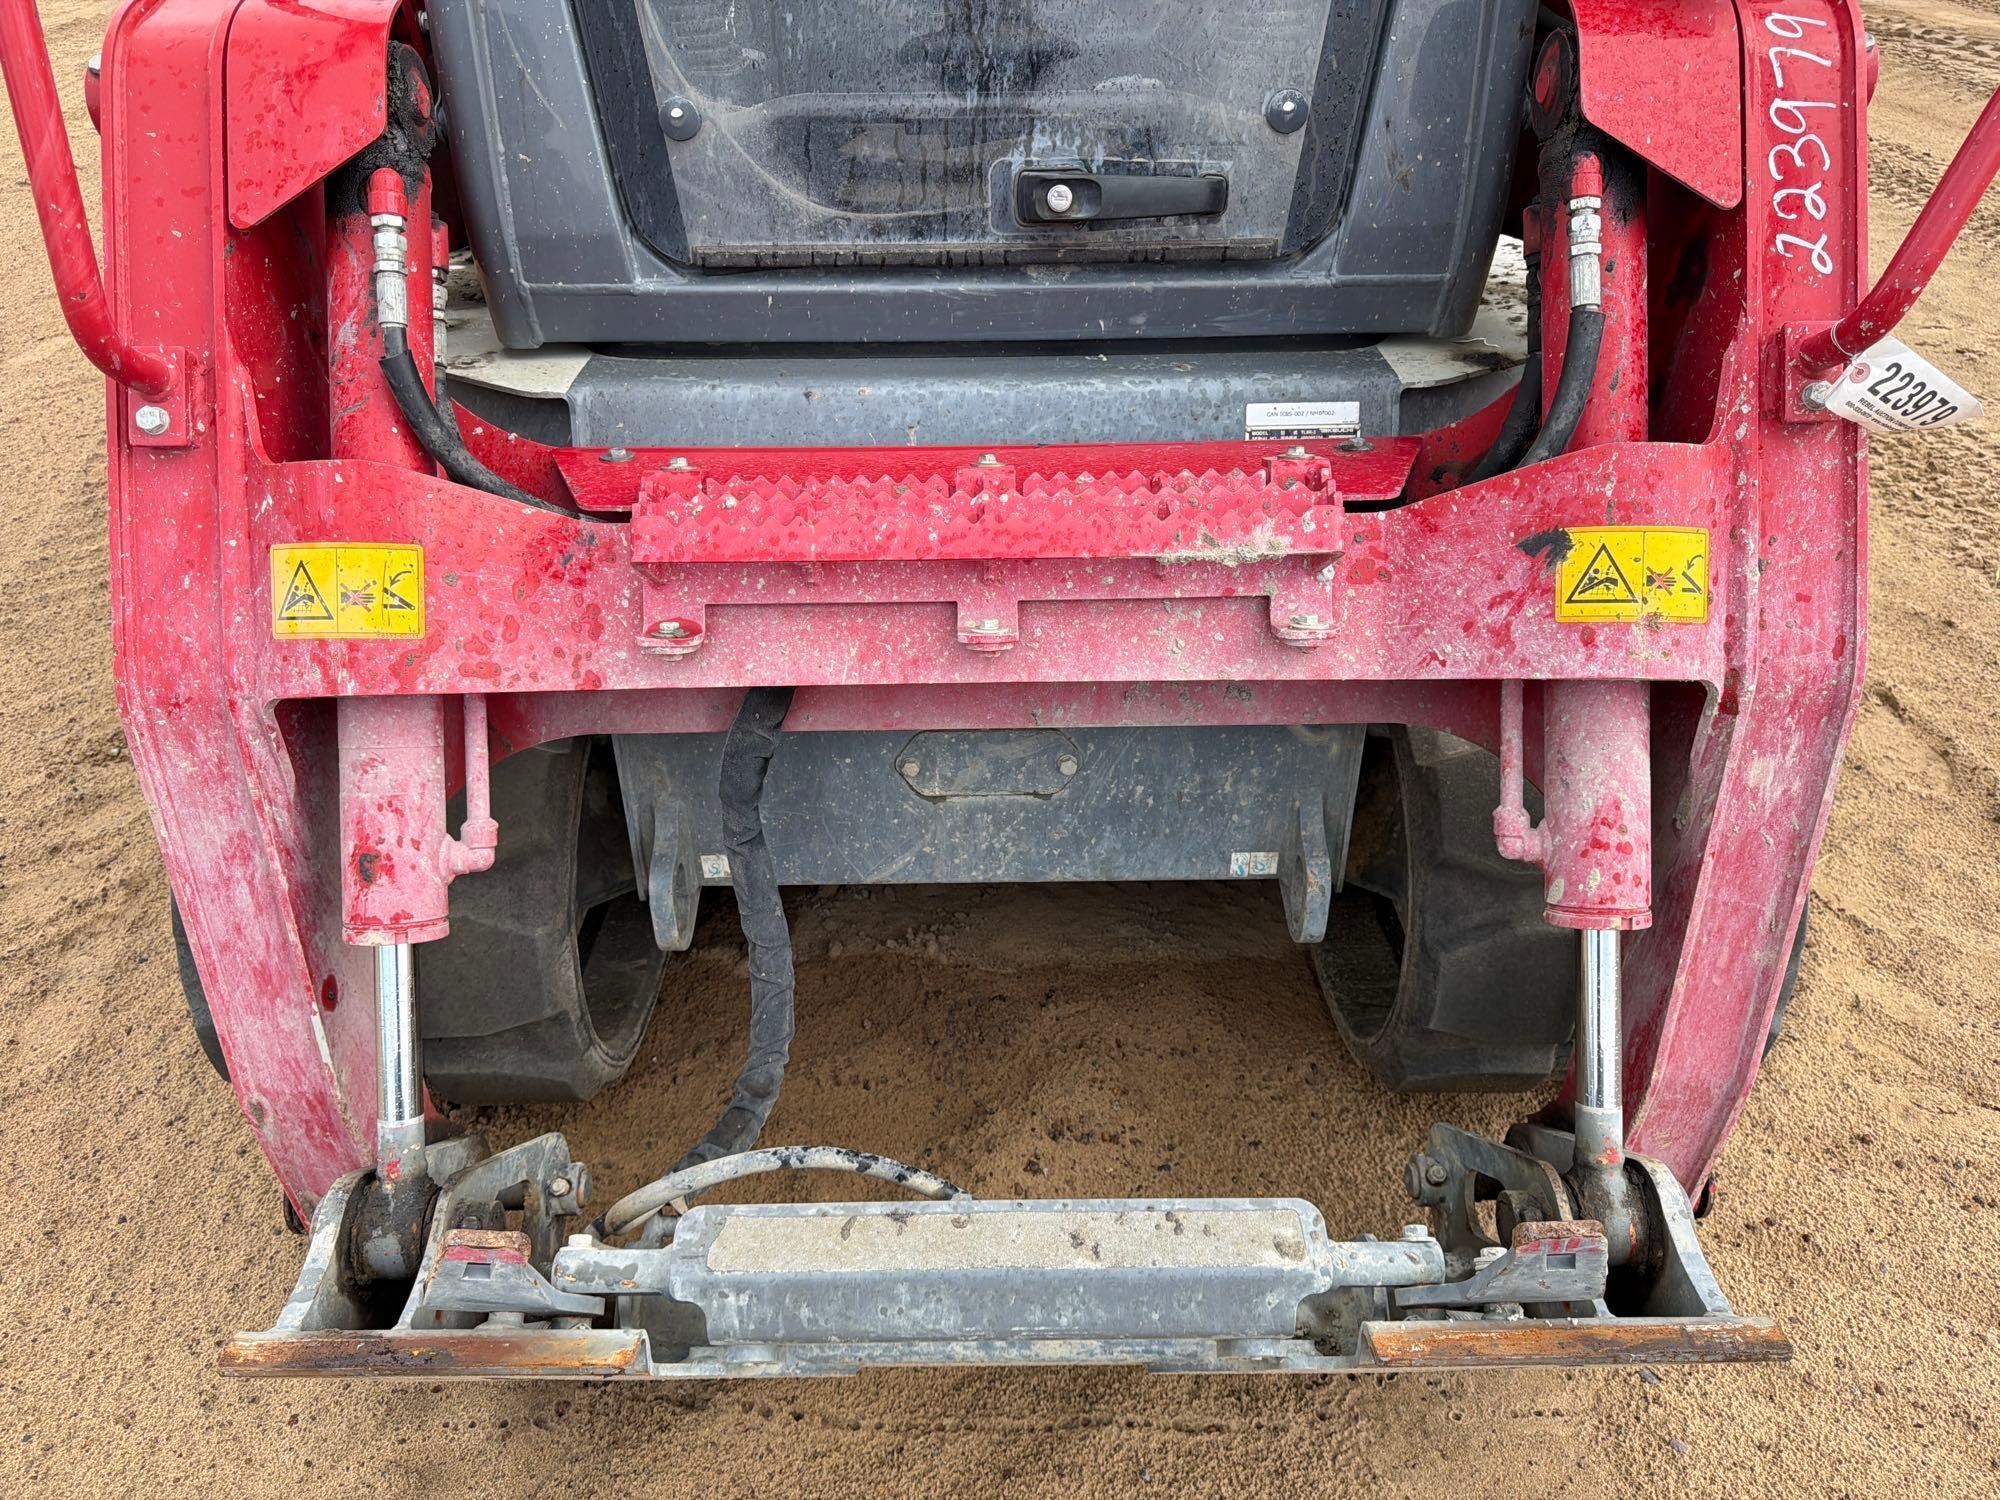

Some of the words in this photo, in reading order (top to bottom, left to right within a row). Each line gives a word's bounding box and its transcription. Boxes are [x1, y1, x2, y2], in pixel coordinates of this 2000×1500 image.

[1764, 12, 1836, 275] 223979
[1857, 397, 1876, 411] REBEL
[1873, 408, 1896, 422] AUCTION
[1867, 362, 1958, 426] 223979
